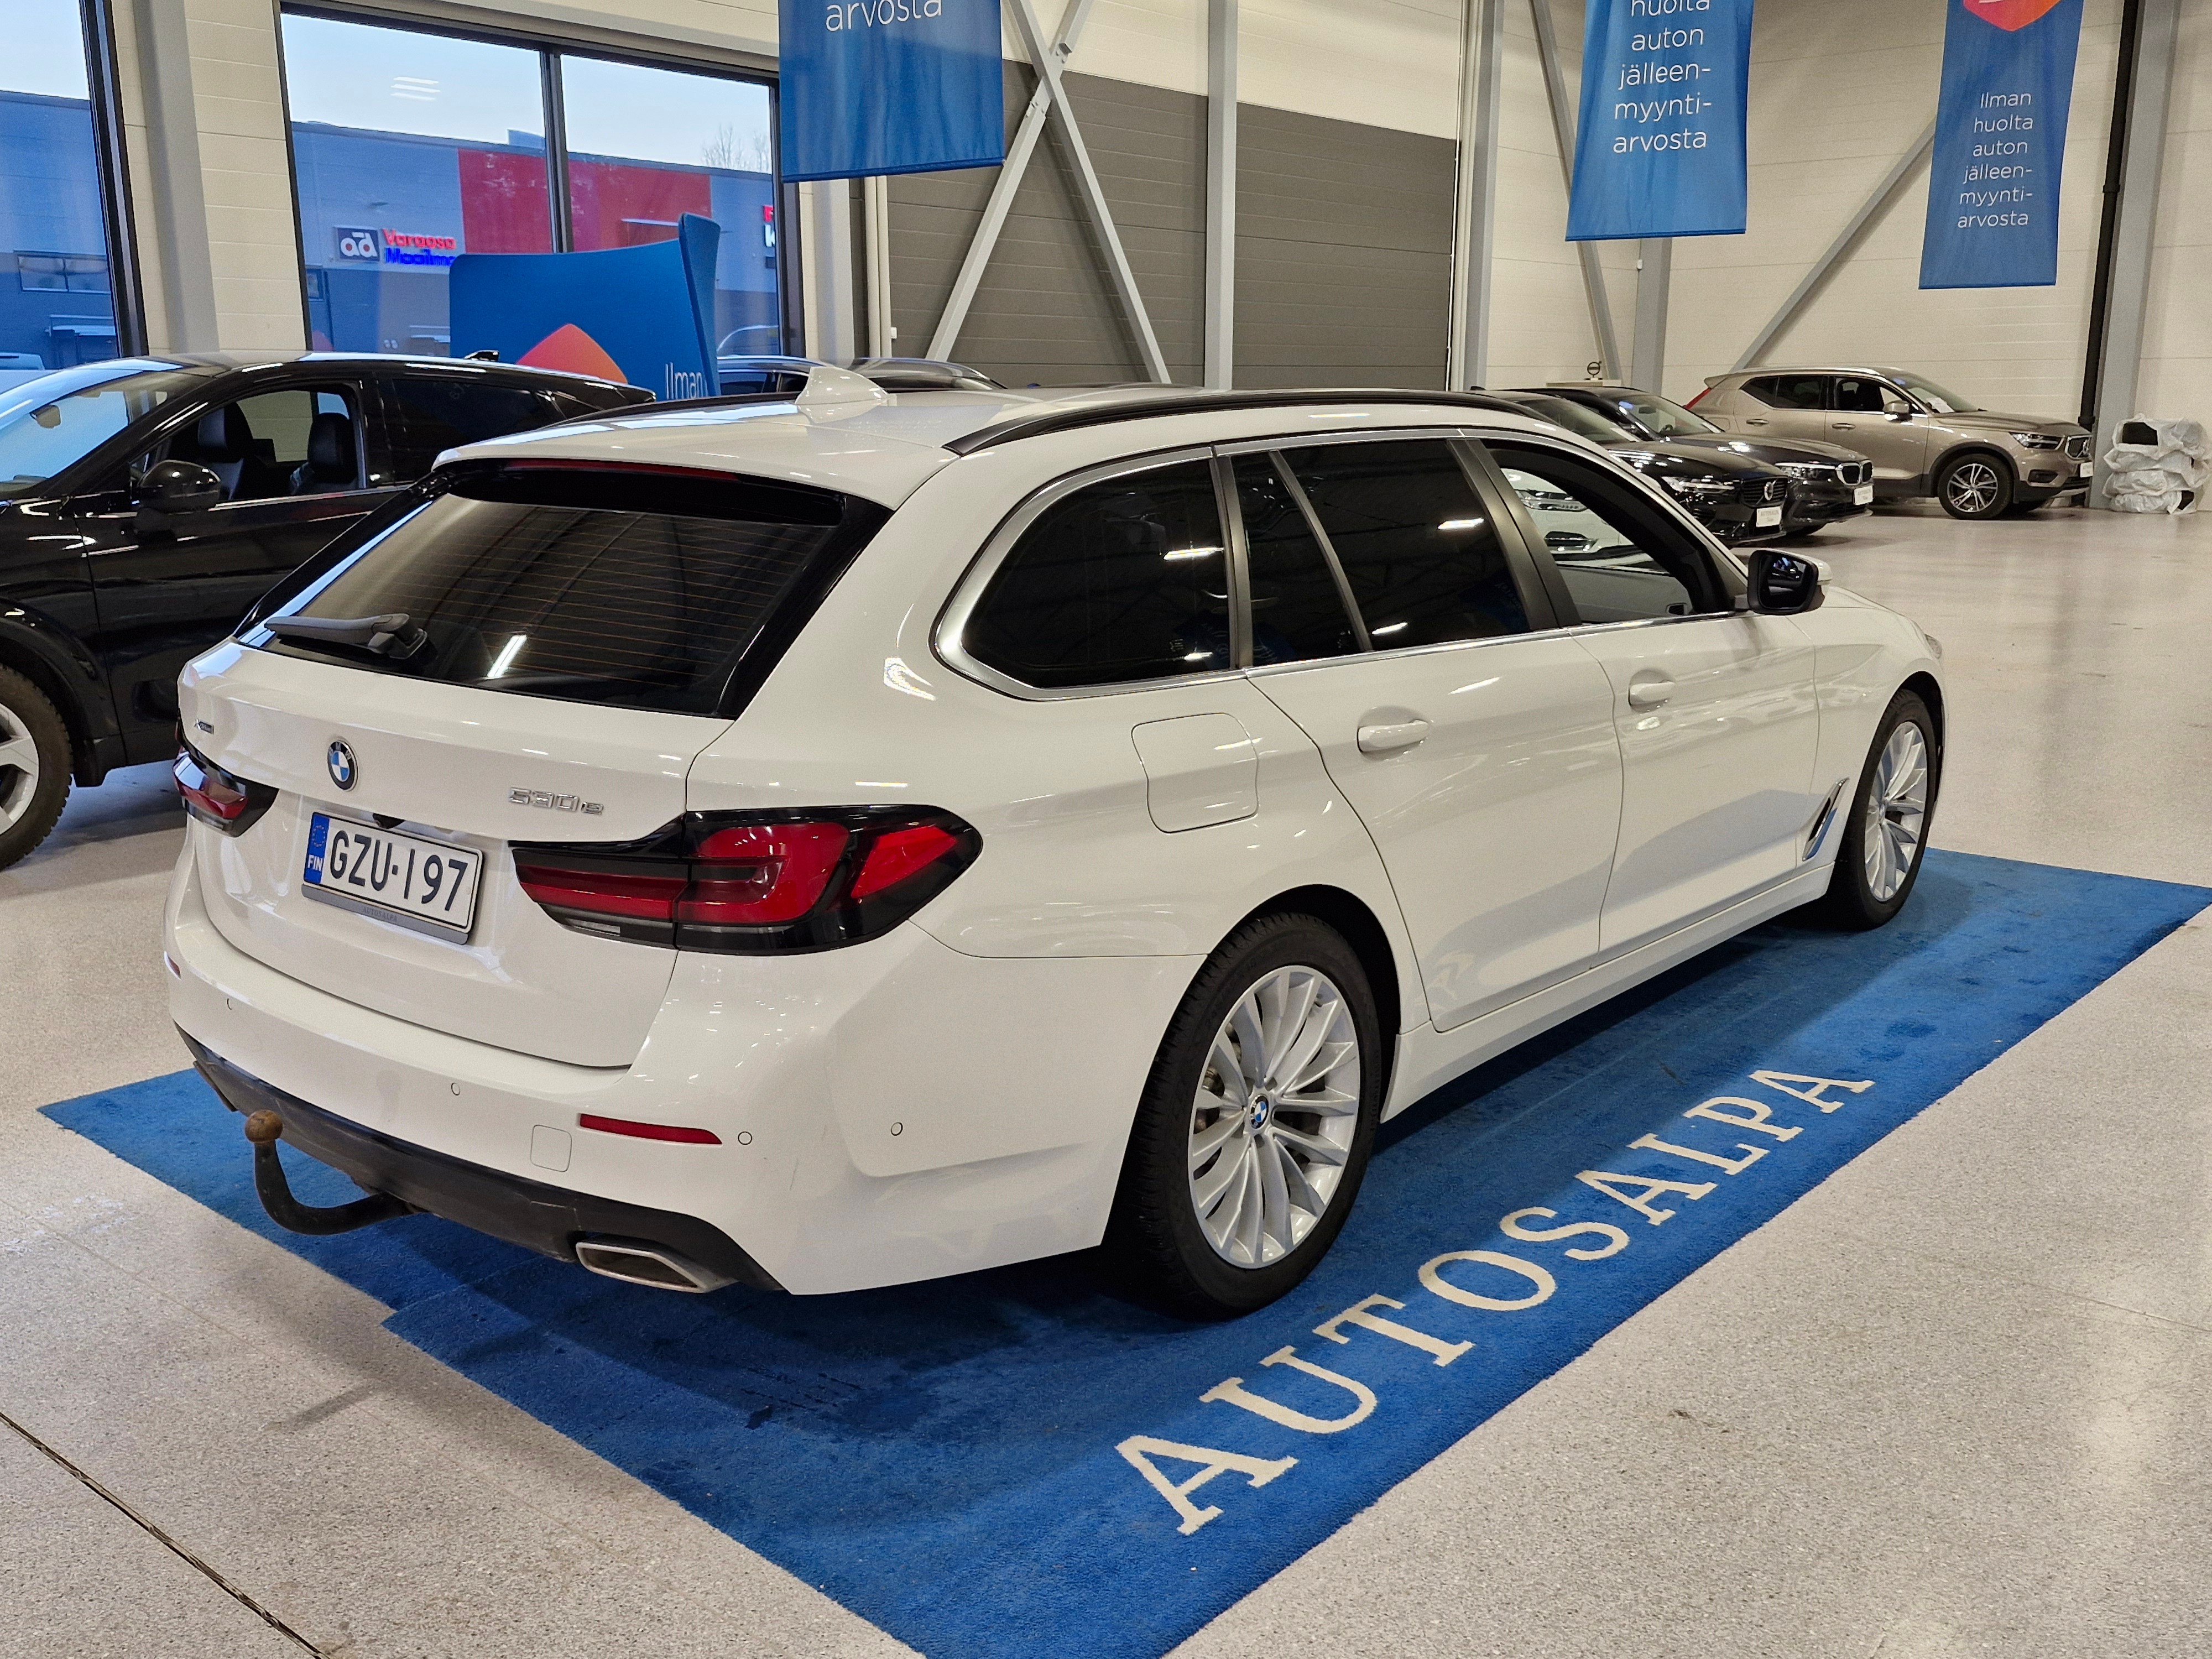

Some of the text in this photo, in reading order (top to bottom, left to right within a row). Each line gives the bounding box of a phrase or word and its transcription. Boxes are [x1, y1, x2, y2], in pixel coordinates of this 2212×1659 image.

[826, 0, 942, 32] arvosta
[1631, 0, 1710, 17] huolta
[1631, 27, 1704, 51] auton
[1618, 62, 1712, 90] jälleen-
[1614, 92, 1712, 123] myynti-
[1980, 92, 2032, 109] Ilman
[1974, 114, 2033, 133] huolta
[1613, 128, 1708, 153] arvosta
[1973, 140, 2028, 157] auton
[1963, 164, 2033, 184] jälleen-
[1959, 186, 2033, 207] myynti-
[1958, 211, 2029, 228] arvosta
[665, 362, 705, 399] Ilman
[307, 854, 323, 872] FIN
[330, 830, 468, 911] GZU-197
[1114, 1068, 1875, 1536] AUTOSALPA
